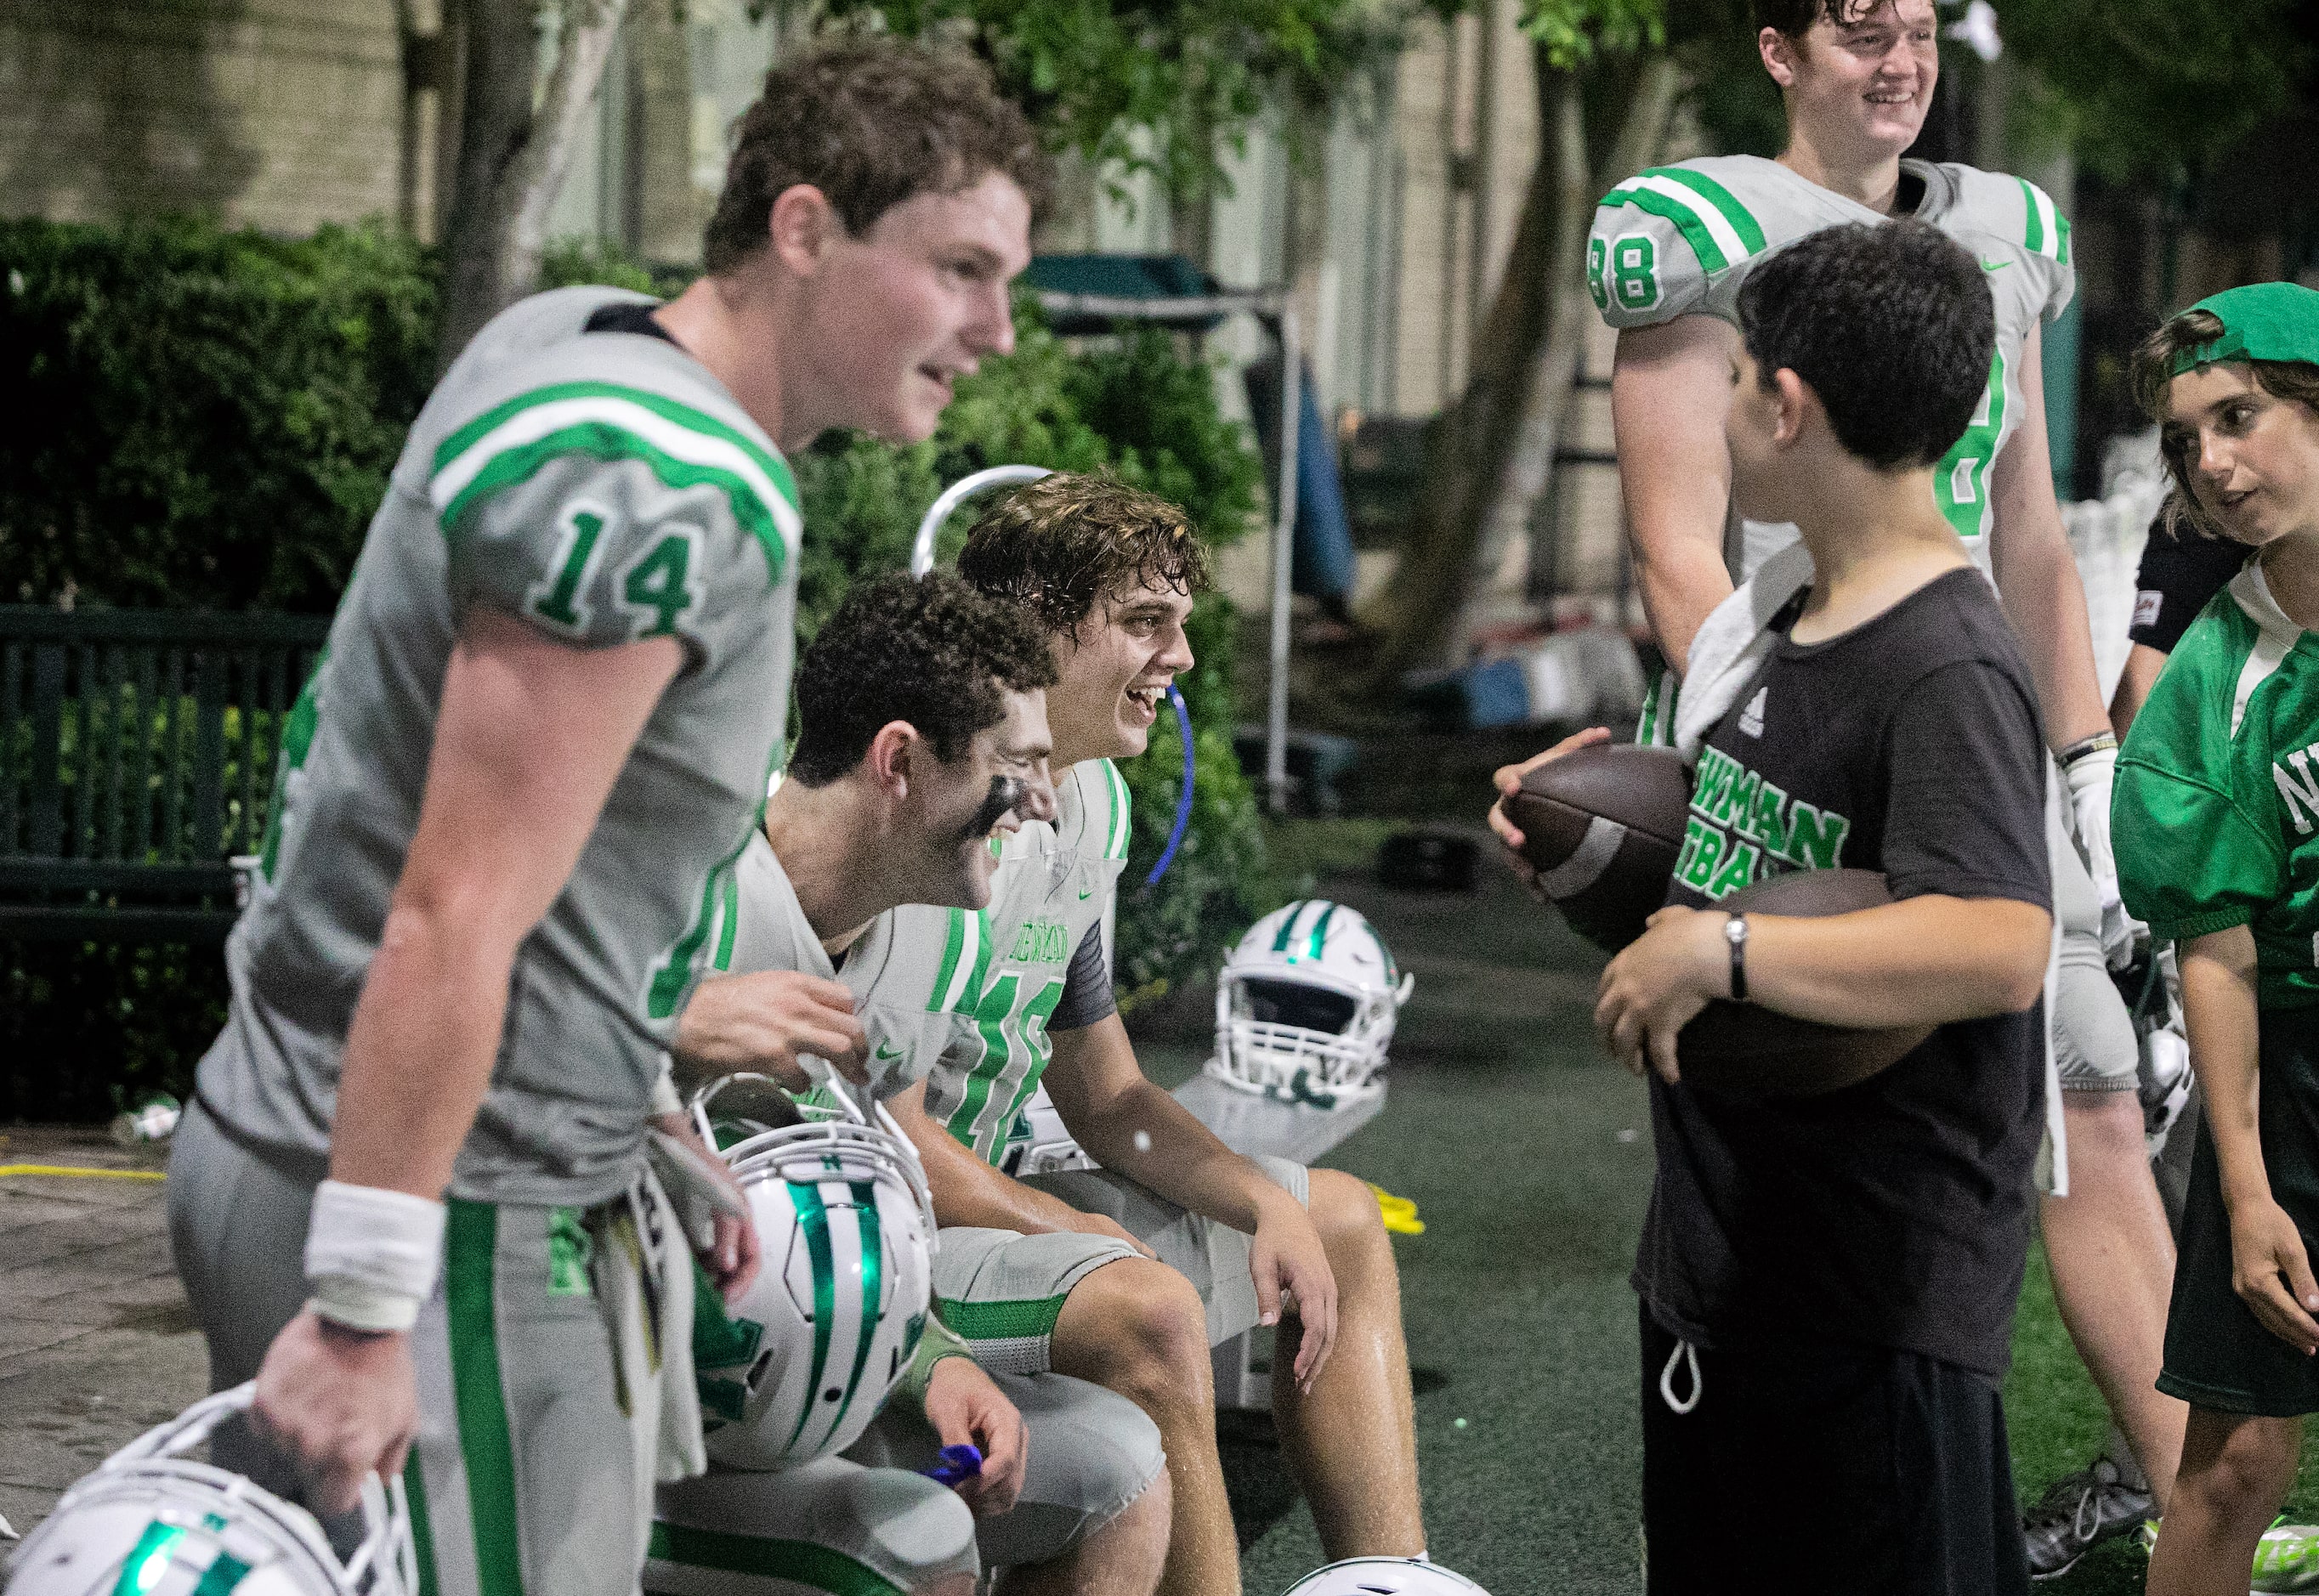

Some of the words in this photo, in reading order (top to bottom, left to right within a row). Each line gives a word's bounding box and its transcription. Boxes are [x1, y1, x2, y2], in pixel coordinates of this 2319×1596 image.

[1586, 231, 1664, 312] 88
[524, 500, 706, 642] 14
[2272, 740, 2319, 835] N
